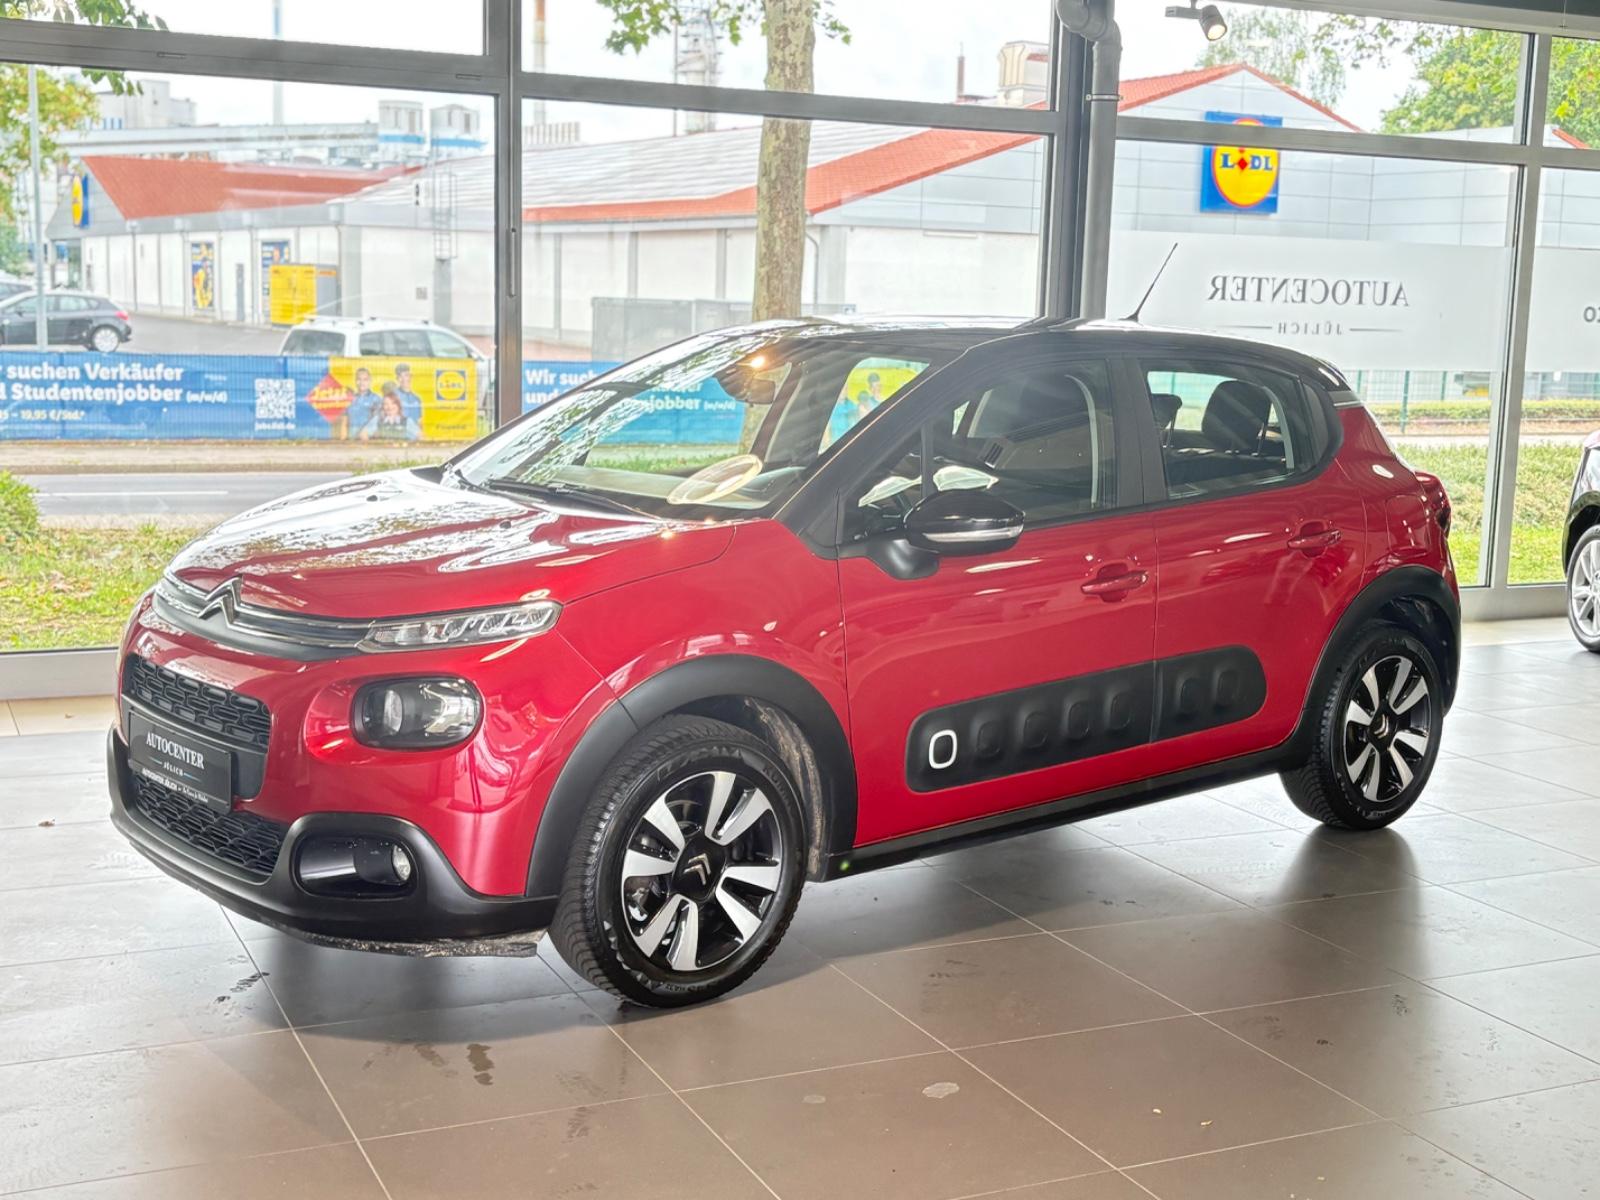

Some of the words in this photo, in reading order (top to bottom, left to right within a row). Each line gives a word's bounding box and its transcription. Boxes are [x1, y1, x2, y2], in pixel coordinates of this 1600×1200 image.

[6, 361, 80, 381] suchen
[83, 362, 184, 381] Verkäufer
[525, 369, 556, 385] Wir
[559, 370, 597, 385] such
[11, 382, 183, 405] Studentenjobber
[146, 732, 205, 770] AUTOCENTER
